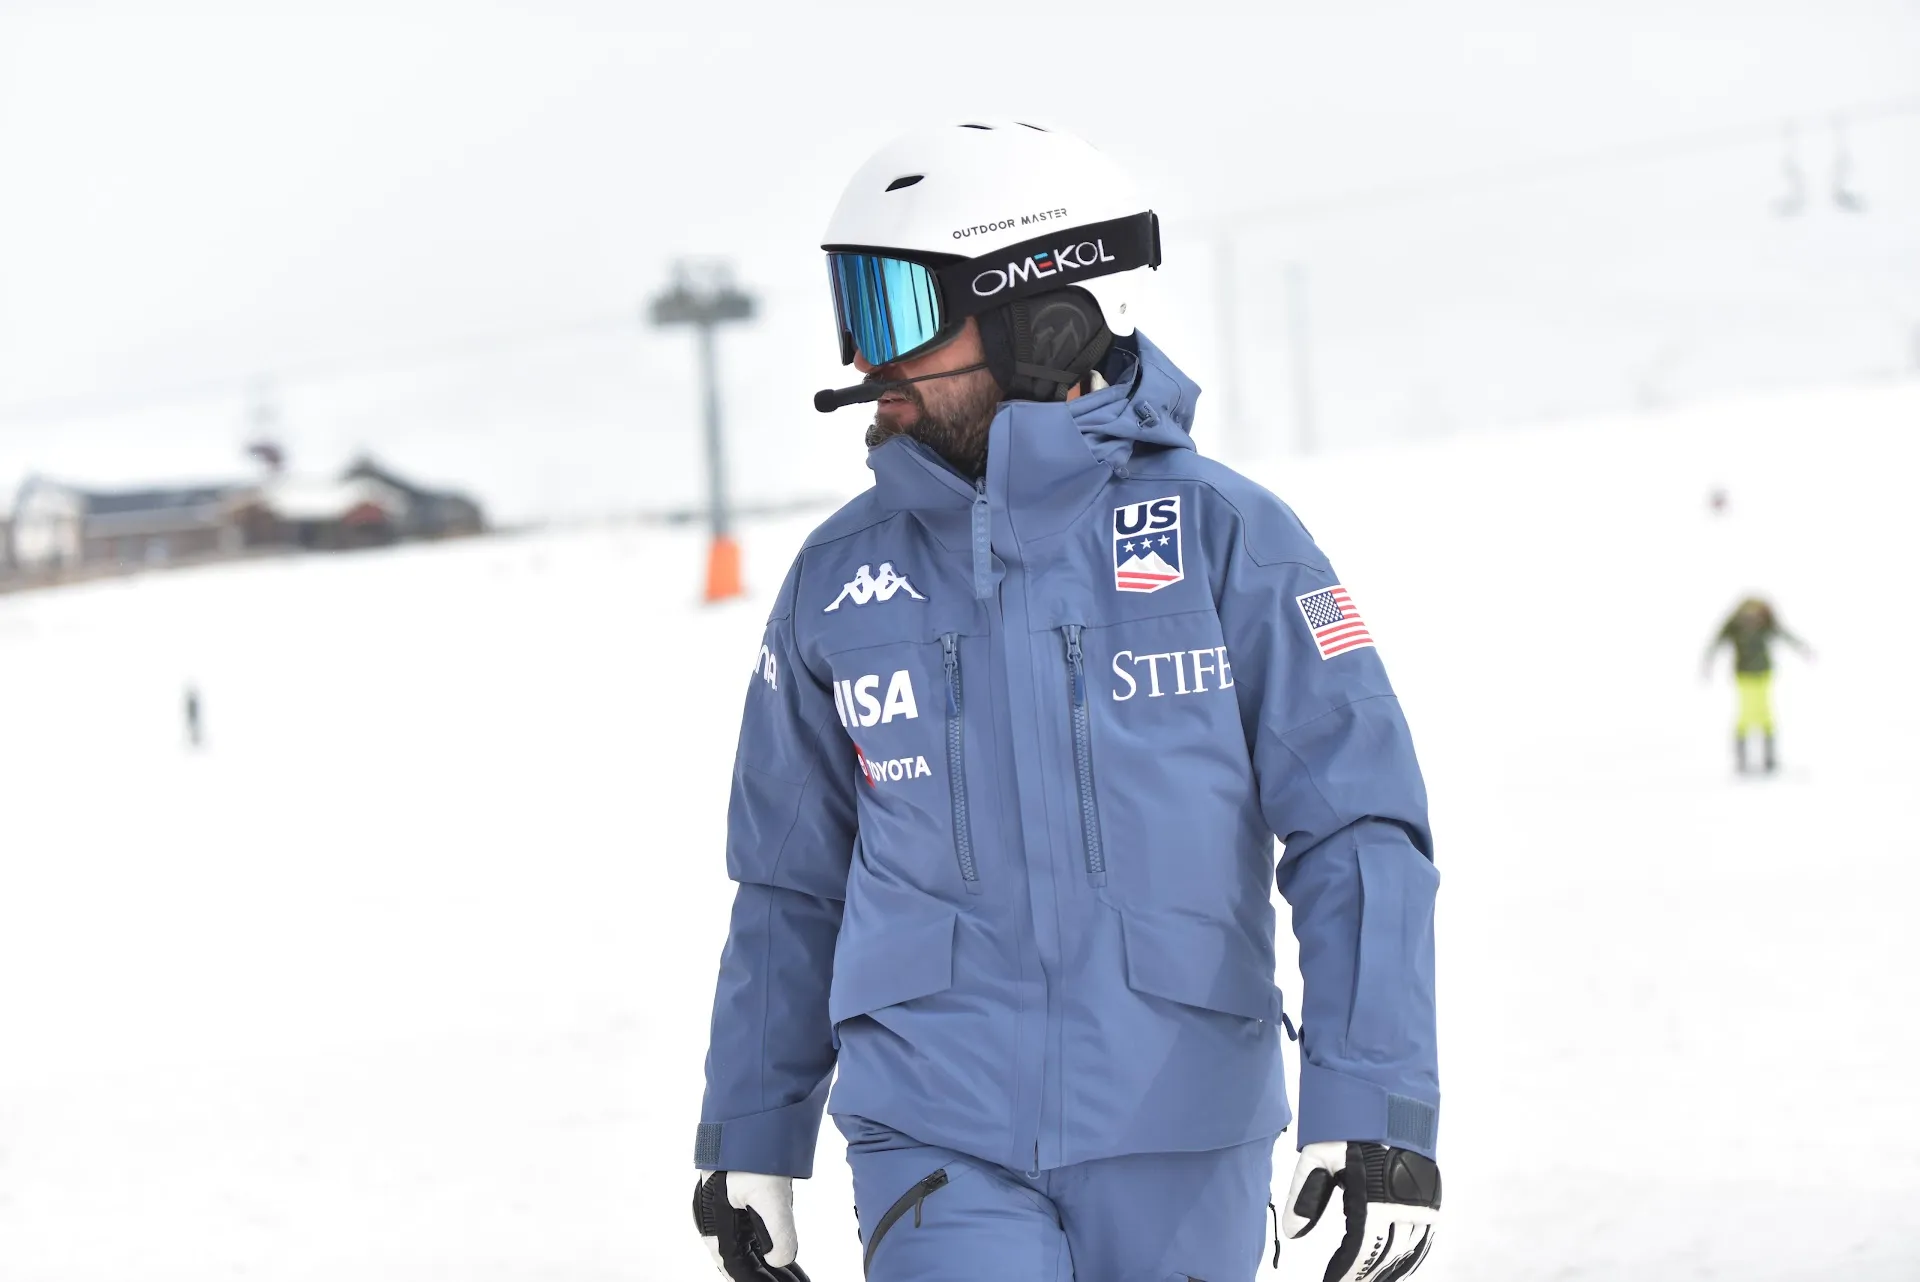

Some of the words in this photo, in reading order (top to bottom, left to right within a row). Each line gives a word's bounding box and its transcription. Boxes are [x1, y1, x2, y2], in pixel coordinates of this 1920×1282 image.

[952, 219, 1016, 240] OUTDOOR
[1021, 207, 1068, 226] MASTER
[971, 239, 1116, 297] OMEKOL
[1115, 499, 1177, 536] US
[865, 755, 932, 782] TOYOTA
